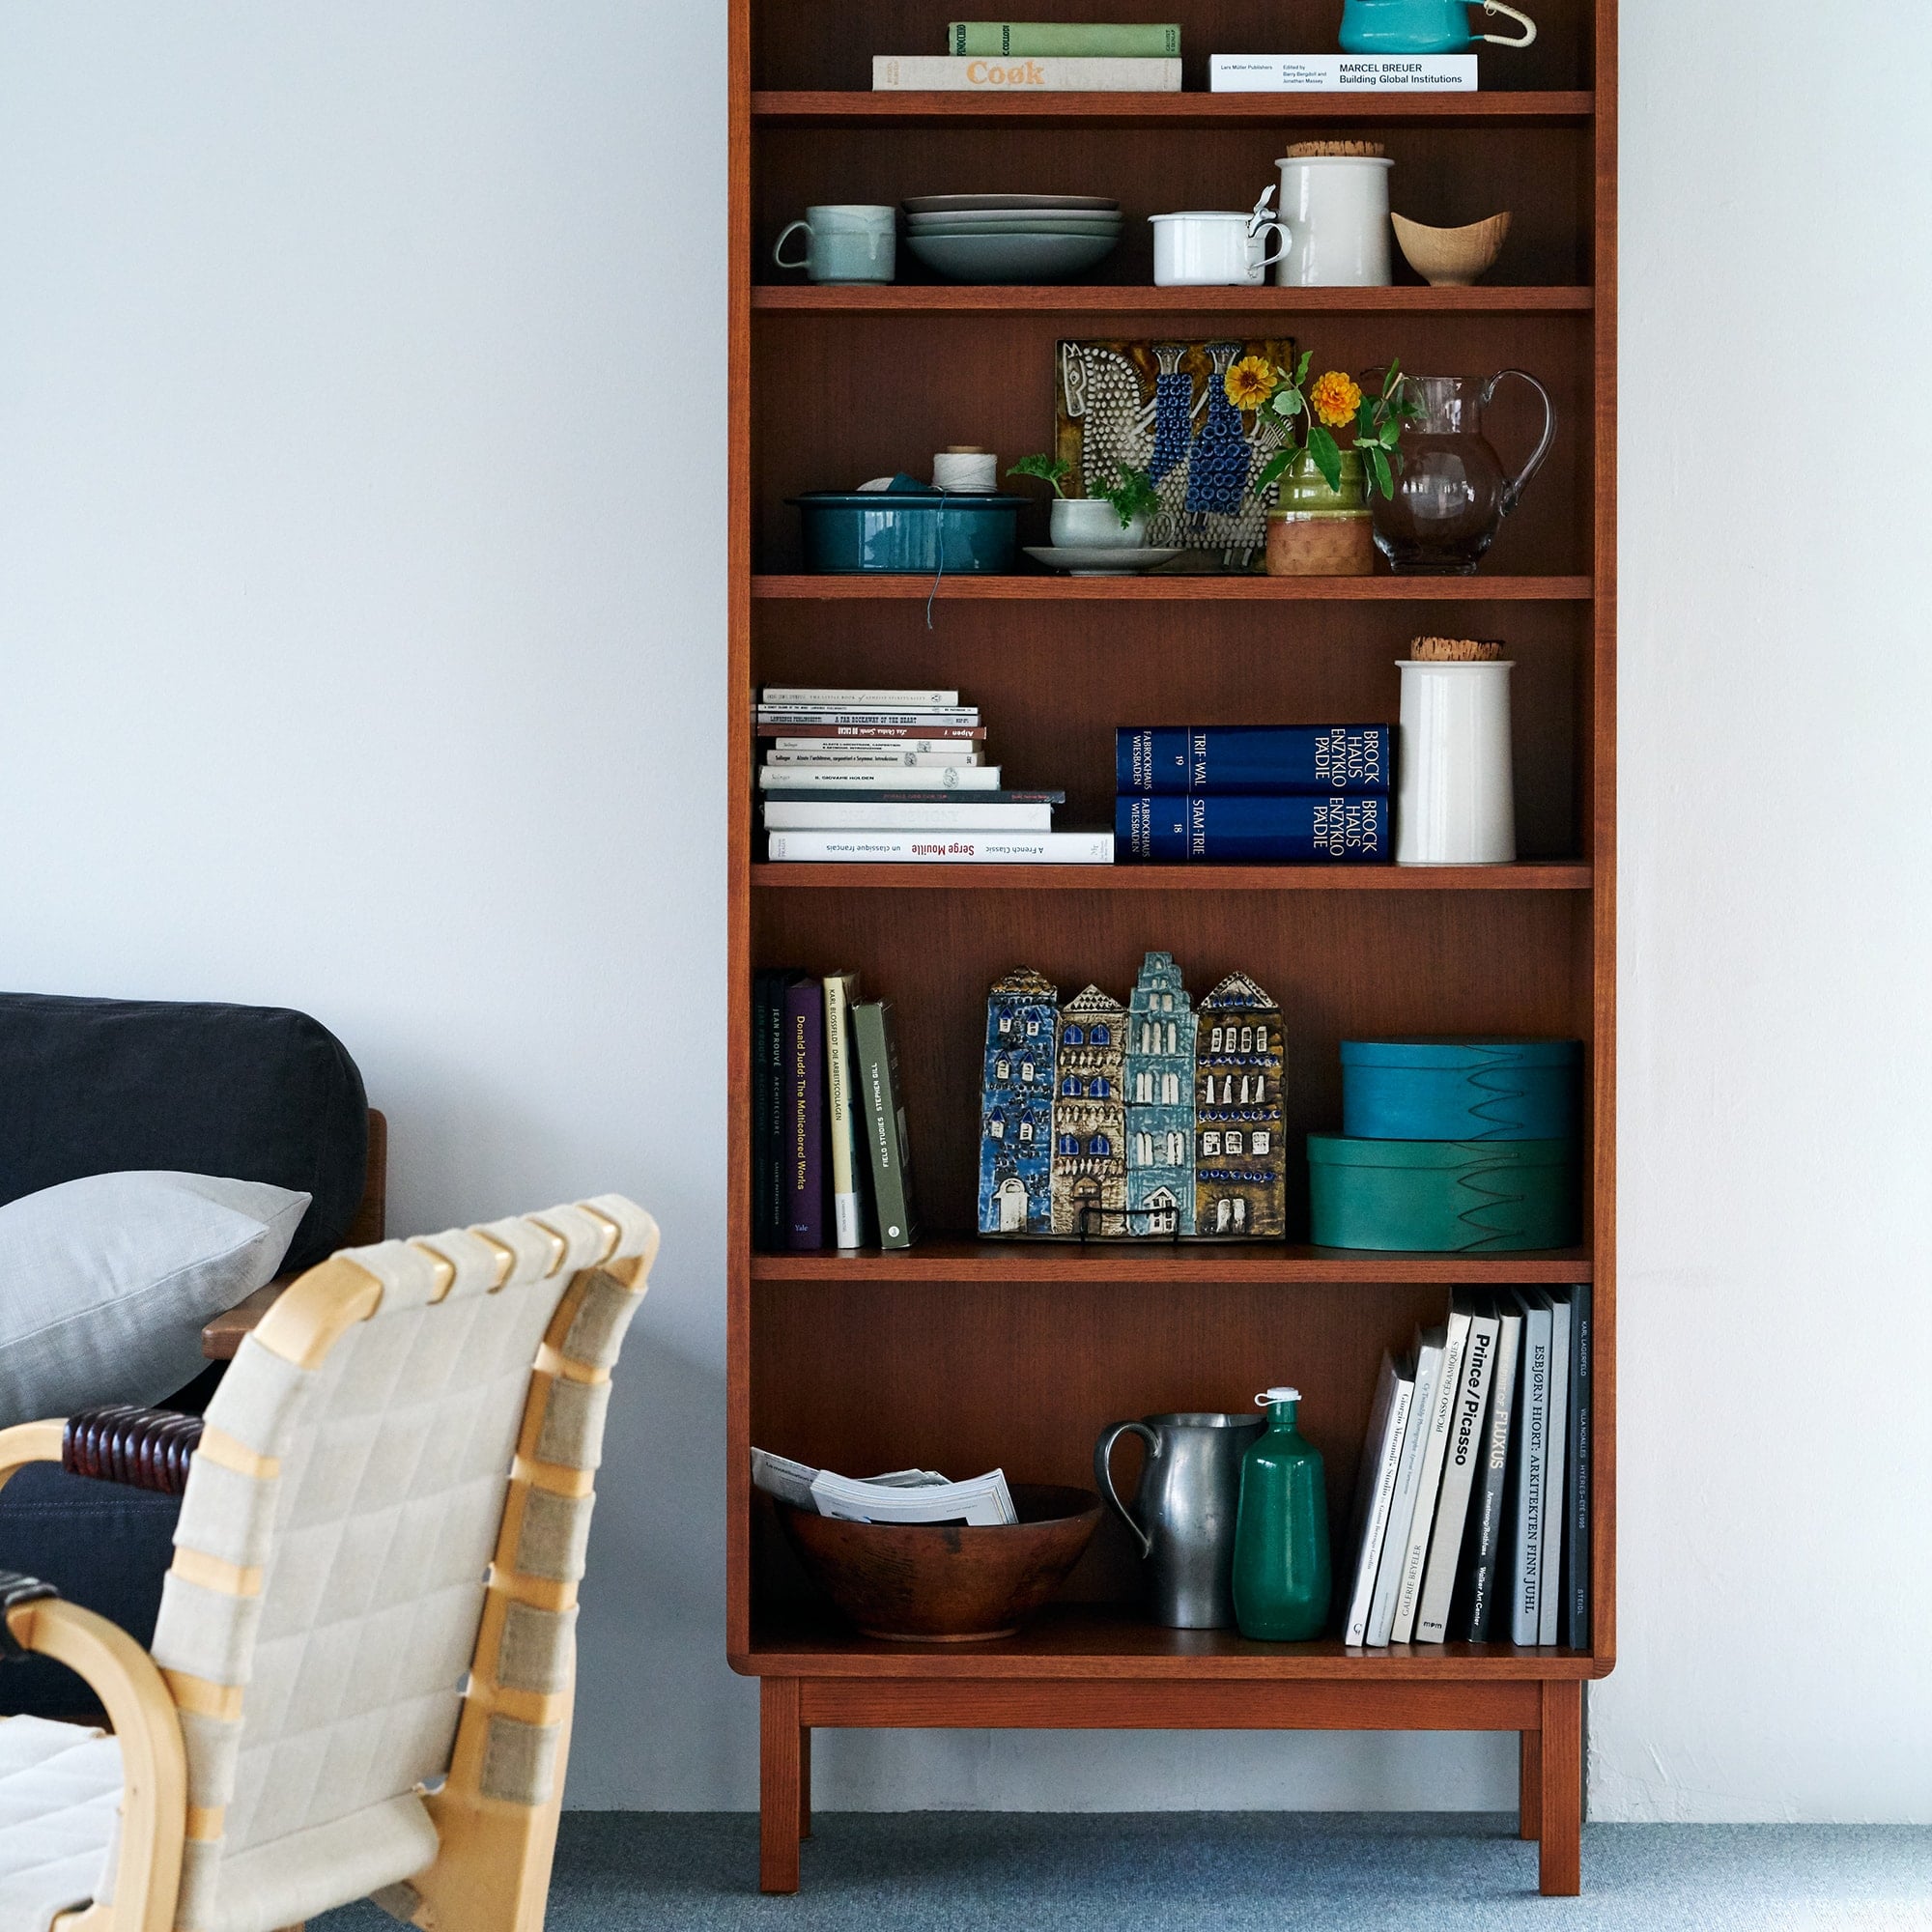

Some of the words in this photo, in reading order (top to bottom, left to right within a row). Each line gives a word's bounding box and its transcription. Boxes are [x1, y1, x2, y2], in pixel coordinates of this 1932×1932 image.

[1339, 64, 1379, 72] MARCEL
[1382, 64, 1422, 72] BREUER
[1339, 74, 1377, 85] Building
[1378, 74, 1408, 83] Global
[1410, 74, 1463, 83] Institutions
[1132, 735, 1142, 785] WIESBADEN
[1175, 755, 1184, 766] 19
[1315, 737, 1330, 780] PÄDIE
[1331, 728, 1347, 787] ENZYKLO
[1348, 736, 1363, 778] HAUS
[1363, 731, 1379, 784] BROCK
[1131, 803, 1140, 853] WIESBADEN
[1174, 823, 1182, 833] 18
[1192, 799, 1205, 855] STAM-TRIE
[1313, 806, 1328, 849] PÄDIE
[1328, 797, 1345, 856] ENZYKLO
[1345, 806, 1361, 847] HAUS
[1361, 800, 1378, 853] BROCK
[911, 843, 946, 854] Mouille
[948, 842, 975, 855] Serge
[797, 1015, 806, 1049] Donald
[830, 1008, 838, 1045] BLOSSFELDT
[773, 1032, 781, 1066] PROUVÉ
[797, 1051, 806, 1077] Judd:
[797, 1080, 806, 1097] The
[833, 1061, 842, 1121] ARBEITSCOLLAGEN
[873, 1080, 883, 1112] STEPHEN
[797, 1099, 806, 1158] Multicolored
[877, 1117, 887, 1146] STUDIES
[797, 1161, 806, 1190] Works
[881, 1148, 890, 1168] FIELD
[1435, 1397, 1449, 1433] PICASSO
[1442, 1341, 1460, 1396] CÉRAMIQUES
[1533, 1346, 1545, 1403] ESBJØRN
[1397, 1393, 1408, 1424] Giorgio
[1491, 1409, 1509, 1469] FLUXUS
[1531, 1406, 1543, 1451] HIORT:
[1382, 1468, 1394, 1496] Studio
[1528, 1456, 1540, 1541] ARKITEKTEN
[1526, 1544, 1537, 1576] FINN
[1402, 1579, 1414, 1617] GALERIE
[1408, 1545, 1423, 1580] BEYELER
[1477, 1566, 1487, 1591] Walker
[1524, 1578, 1535, 1614] JUHL
[1473, 1603, 1483, 1626] Center
